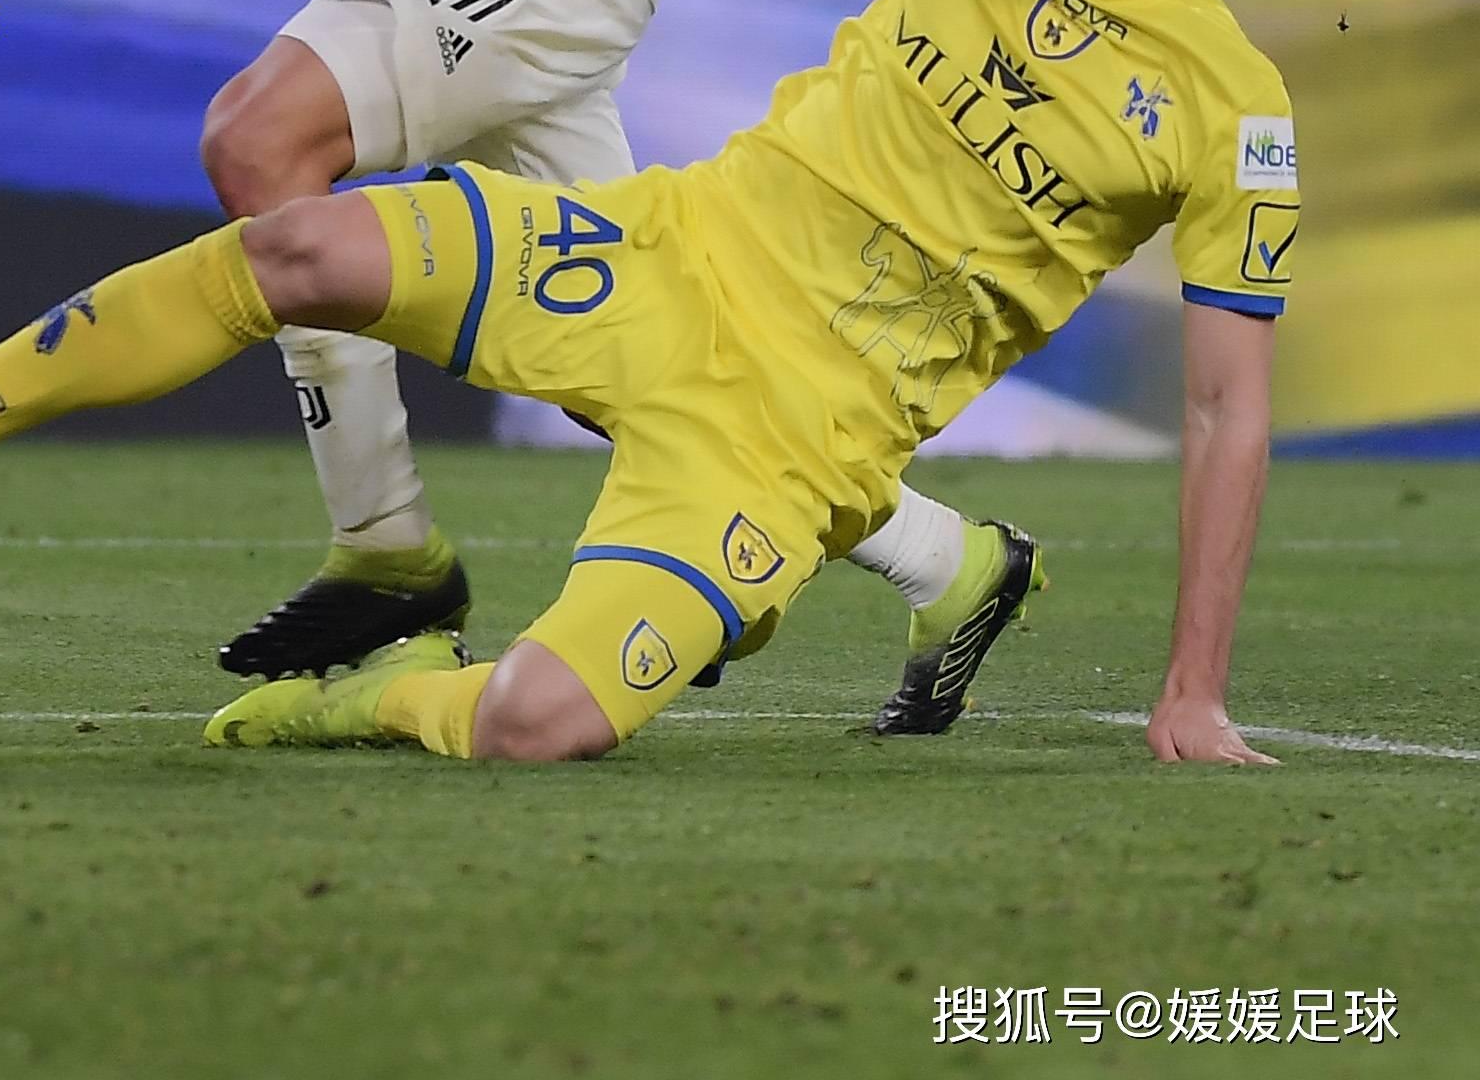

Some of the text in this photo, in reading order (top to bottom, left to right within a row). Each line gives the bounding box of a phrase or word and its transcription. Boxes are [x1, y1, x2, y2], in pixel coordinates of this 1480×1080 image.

[435, 25, 456, 77] adidas
[895, 8, 1090, 230] MULISH
[516, 206, 535, 297] GIVOVA
[534, 195, 623, 315] 40
